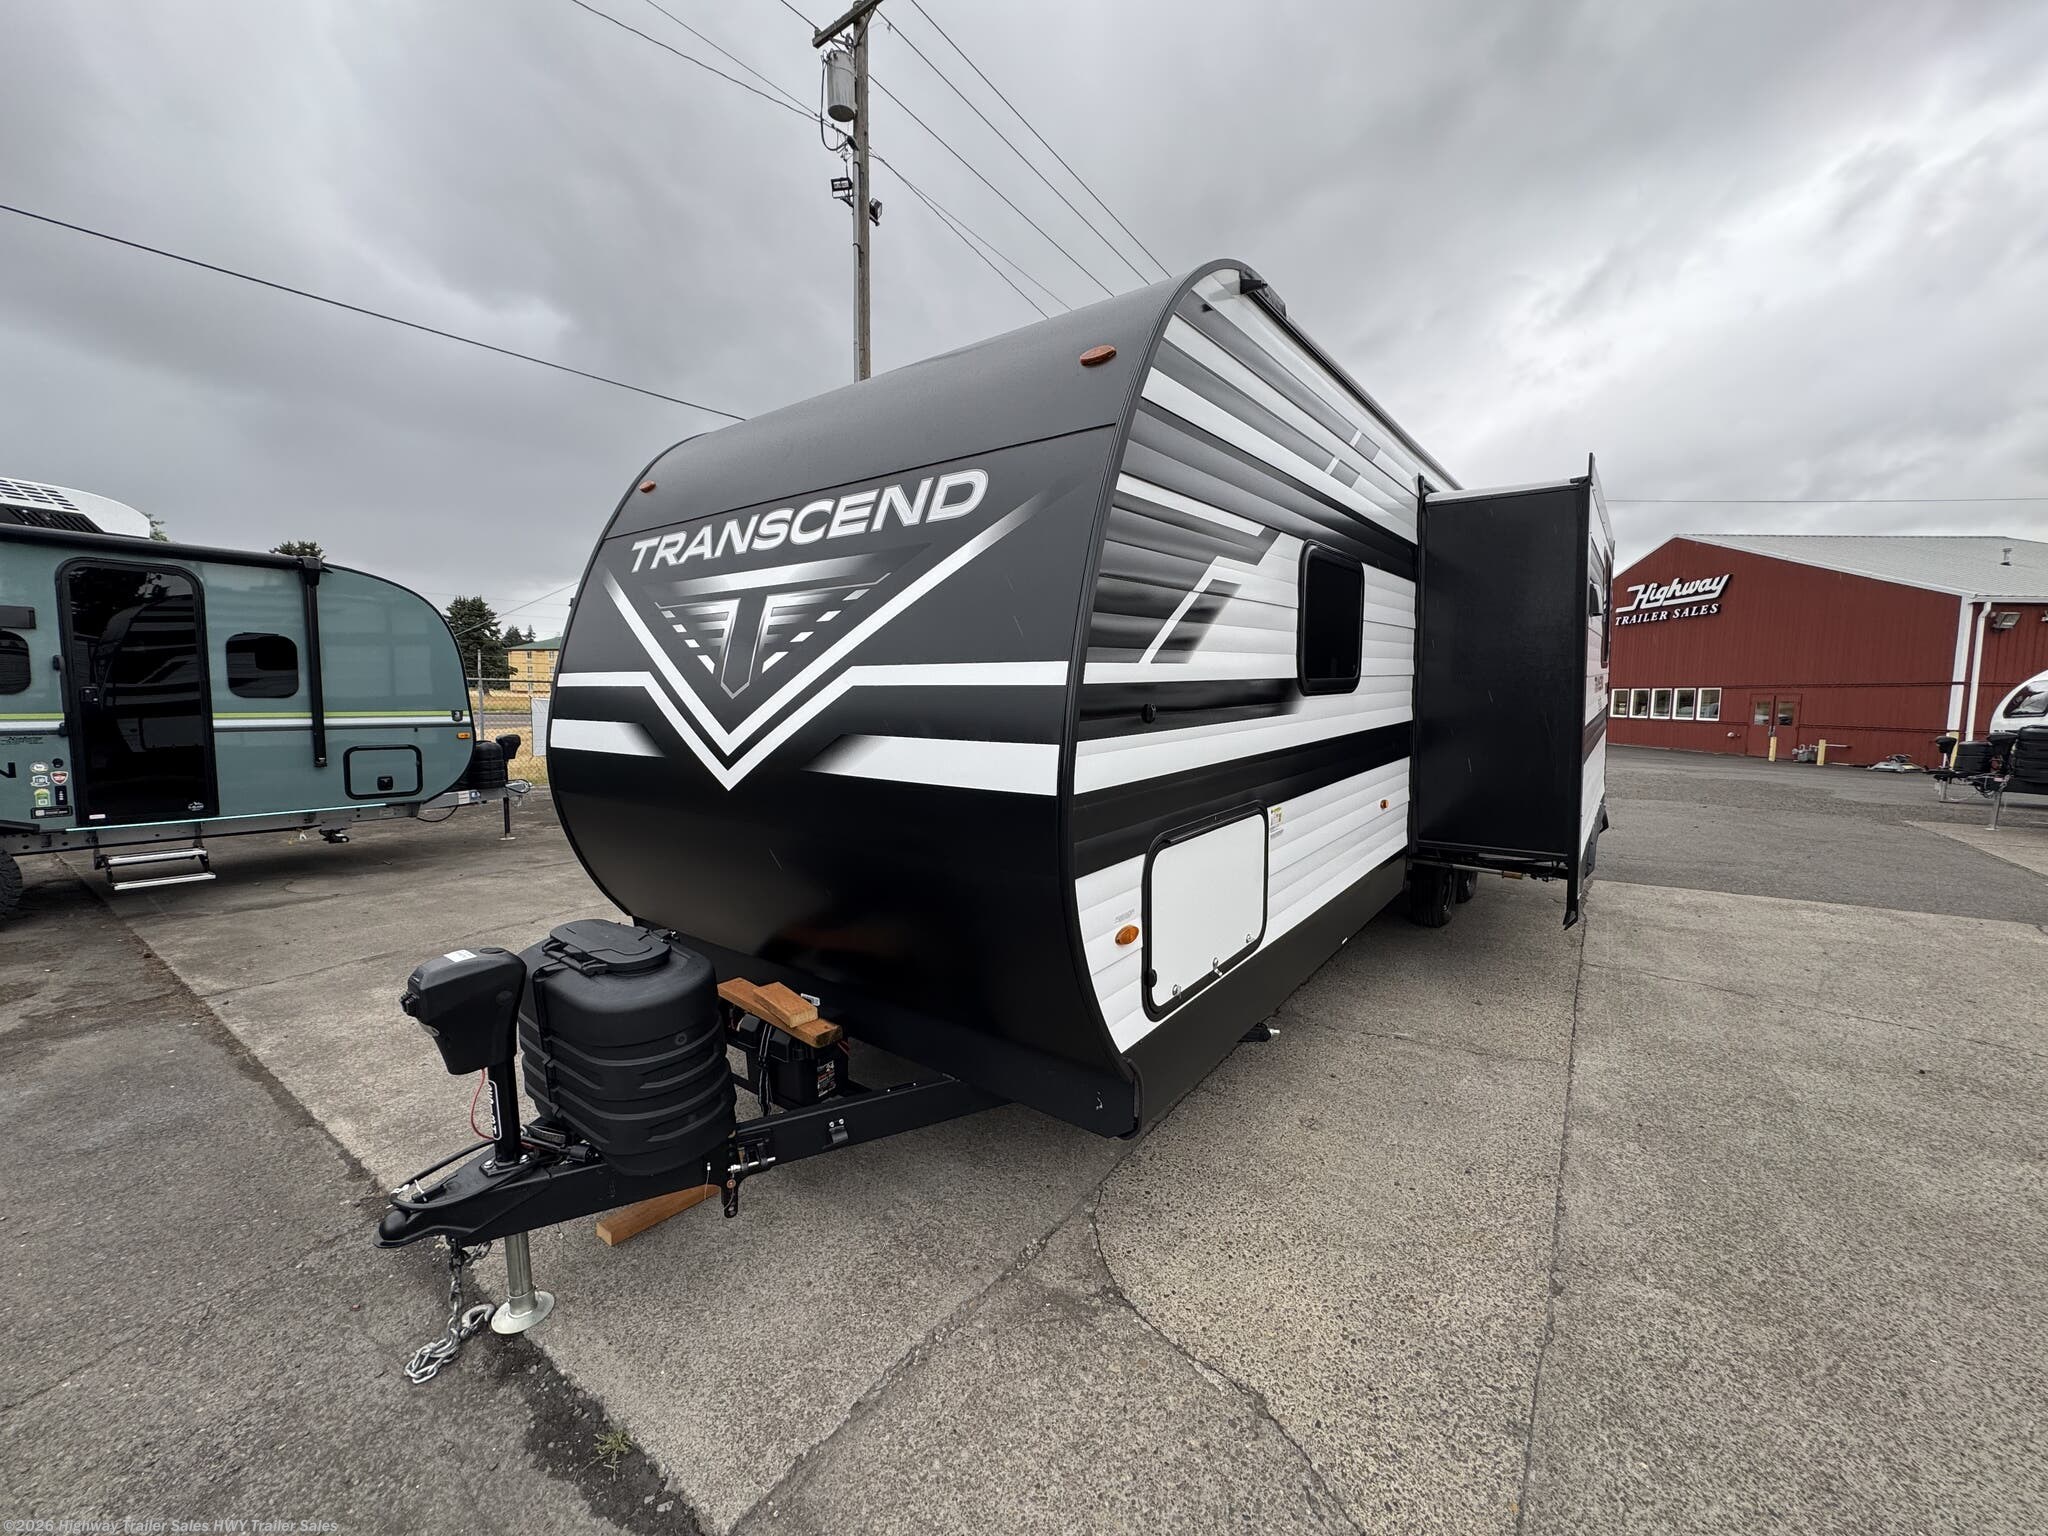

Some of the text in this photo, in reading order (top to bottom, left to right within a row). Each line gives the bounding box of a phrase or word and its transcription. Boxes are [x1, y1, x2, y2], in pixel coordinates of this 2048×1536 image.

[631, 468, 989, 573] TRANSCEND
[1615, 574, 1730, 613] Highway
[1615, 603, 1719, 625] TRAILER SALES
